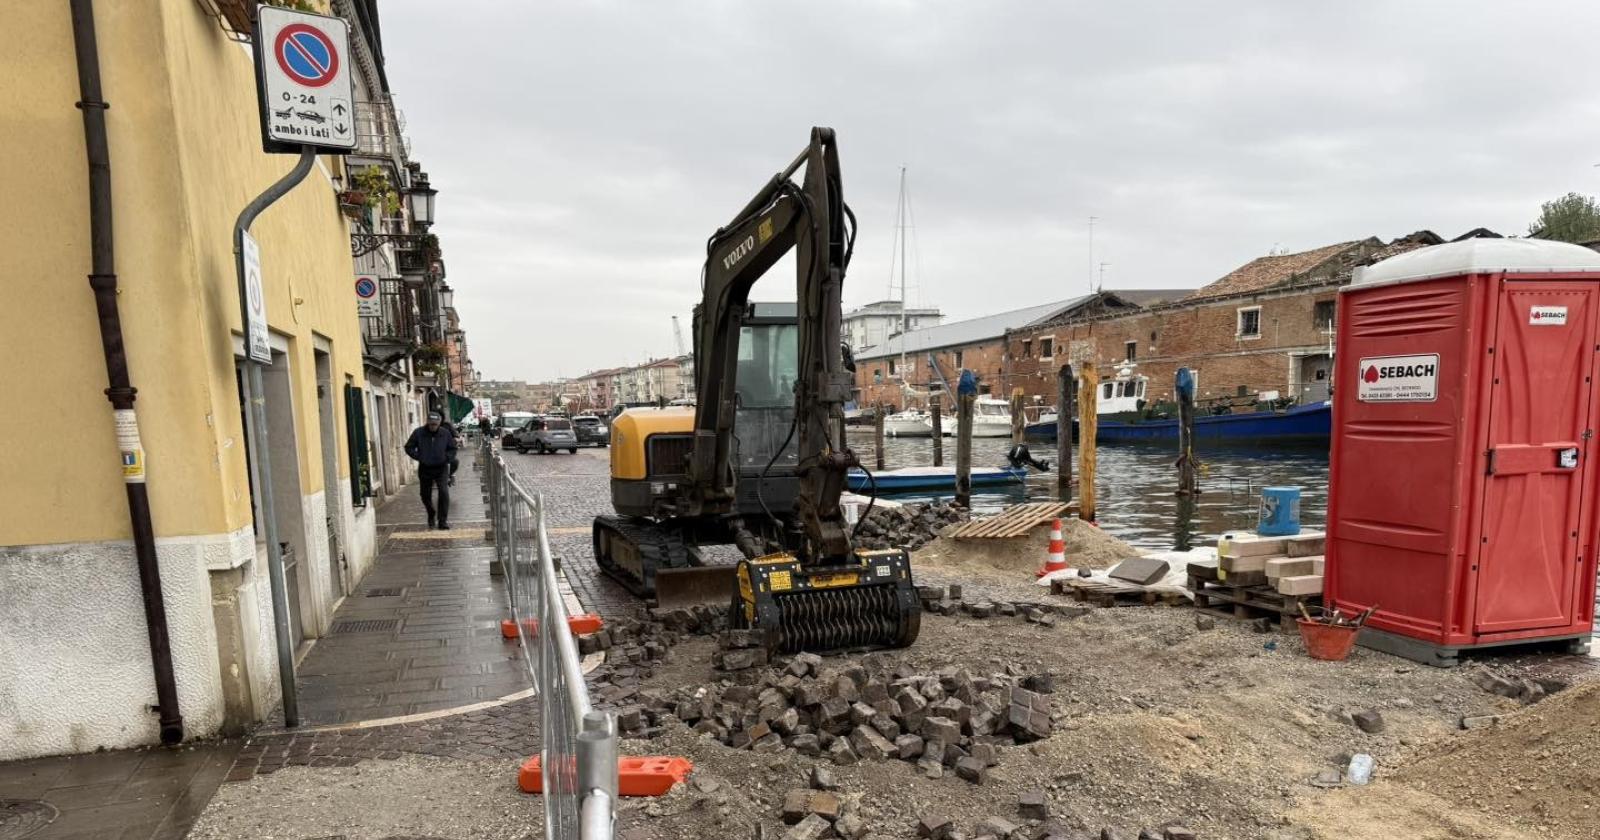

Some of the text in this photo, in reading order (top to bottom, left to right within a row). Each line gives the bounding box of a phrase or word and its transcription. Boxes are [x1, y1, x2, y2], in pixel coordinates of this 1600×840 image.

[275, 124, 302, 135] ambo
[310, 126, 330, 138] lati
[723, 235, 754, 270] VOLVO
[1379, 364, 1435, 379] SEBACH
